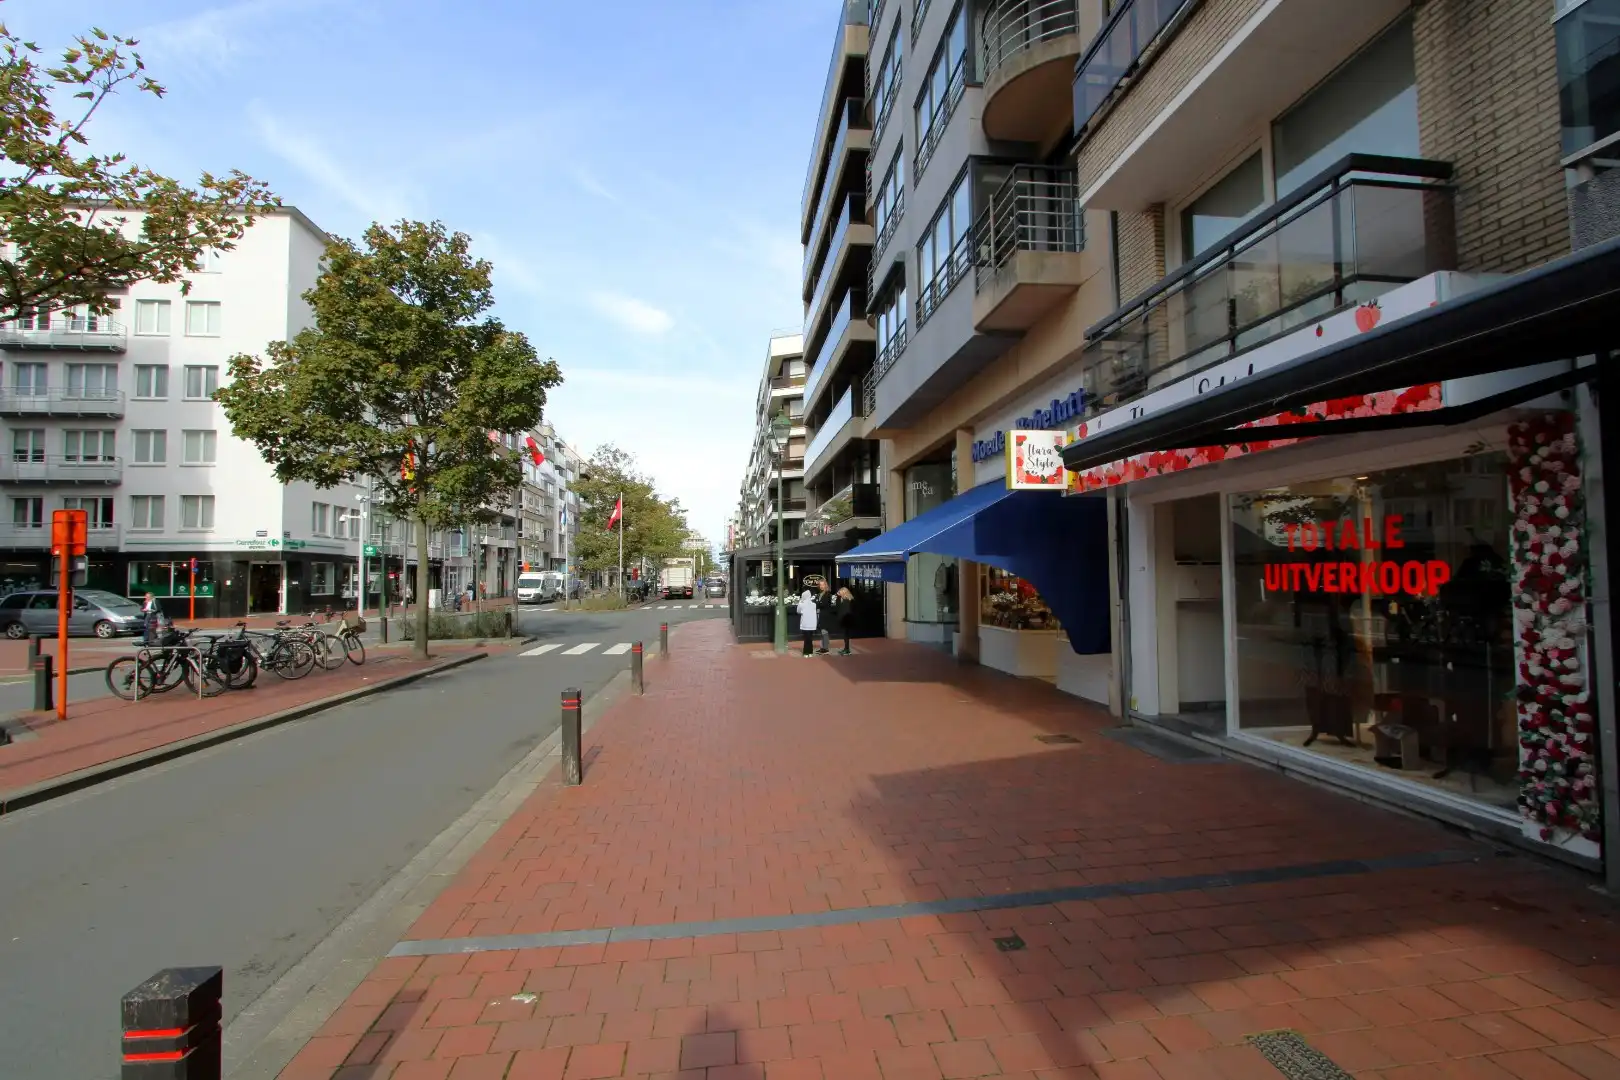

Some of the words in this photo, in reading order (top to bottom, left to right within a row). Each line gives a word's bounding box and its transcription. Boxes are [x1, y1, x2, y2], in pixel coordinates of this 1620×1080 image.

[972, 430, 1006, 462] Moede
[1026, 457, 1055, 472] Style
[1283, 514, 1405, 553] TOTALE
[1264, 560, 1452, 597] UITVERKOOP
